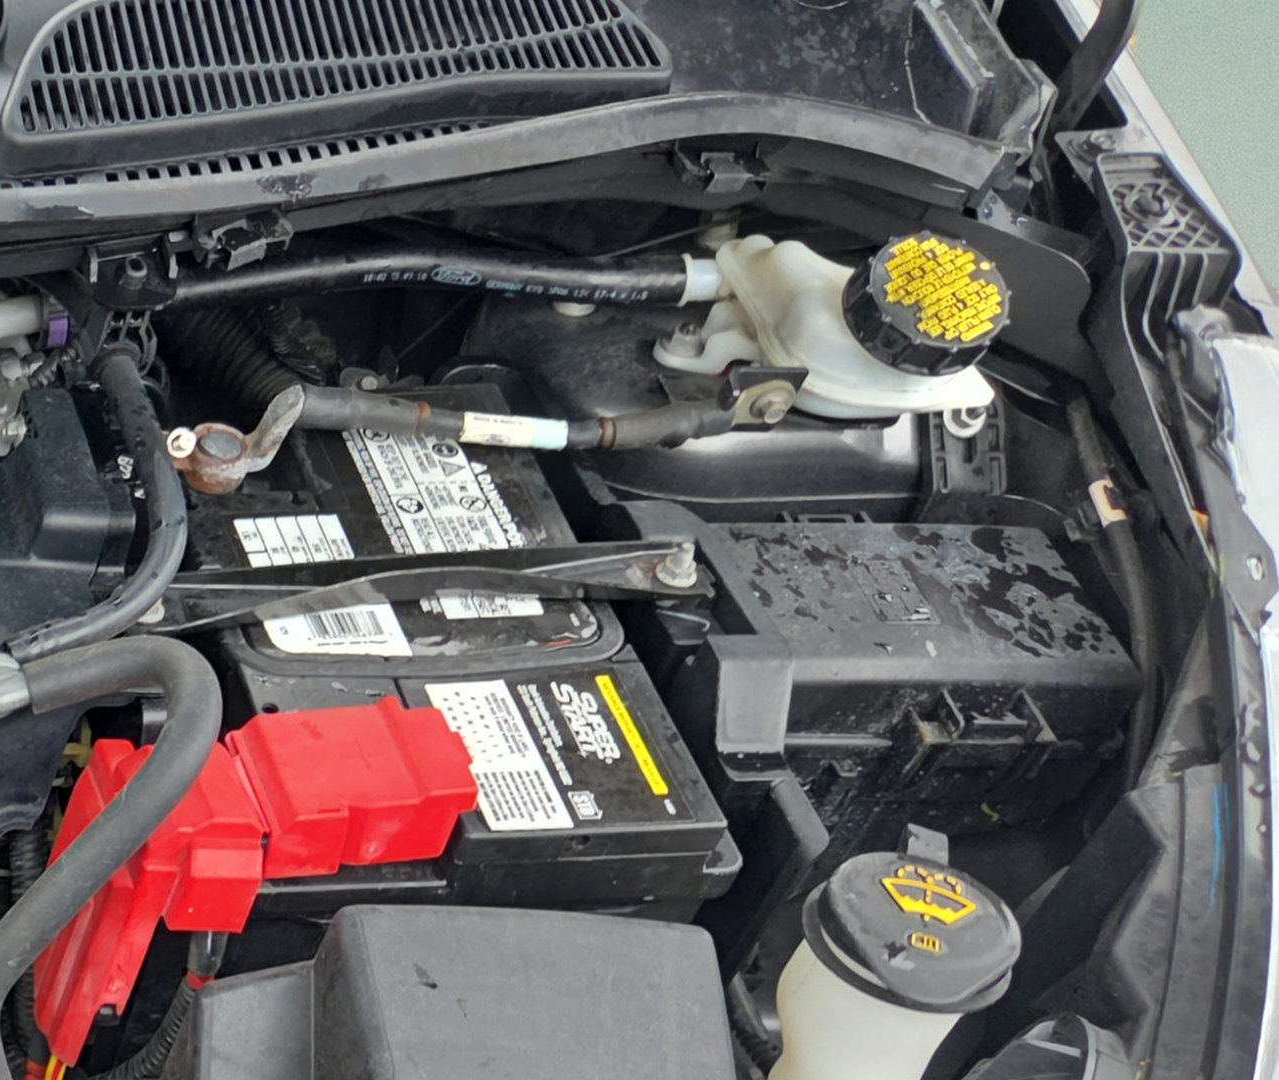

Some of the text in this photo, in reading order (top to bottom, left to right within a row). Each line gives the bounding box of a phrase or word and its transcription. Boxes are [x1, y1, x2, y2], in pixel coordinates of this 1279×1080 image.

[434, 266, 480, 286] Ford
[549, 681, 598, 760] START
[577, 691, 623, 759] SUPER
